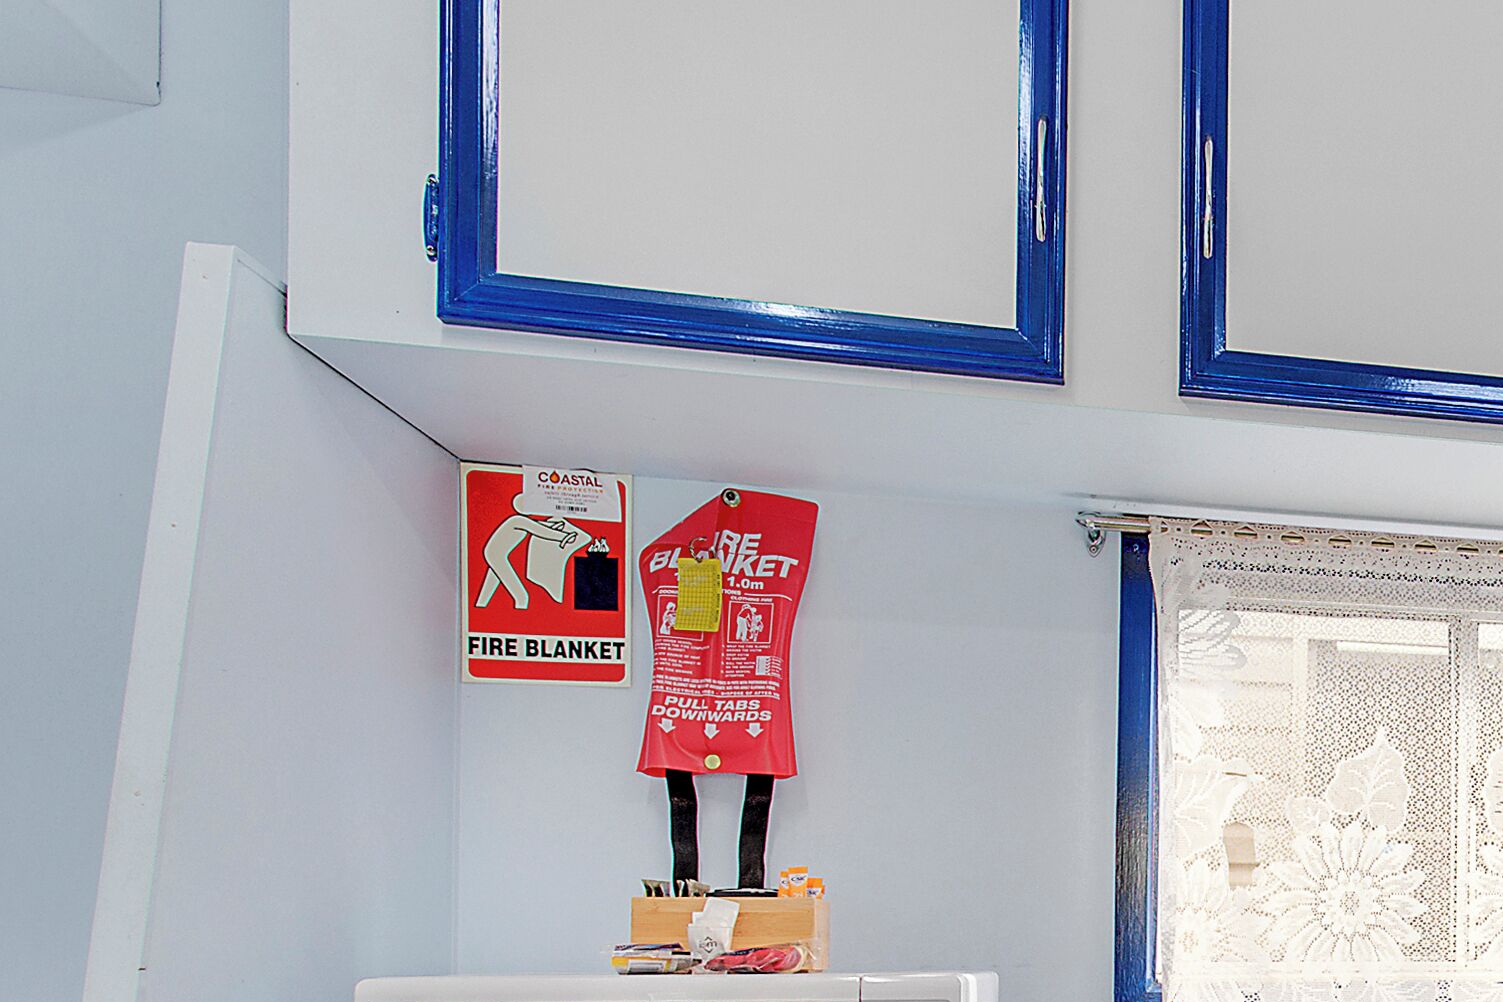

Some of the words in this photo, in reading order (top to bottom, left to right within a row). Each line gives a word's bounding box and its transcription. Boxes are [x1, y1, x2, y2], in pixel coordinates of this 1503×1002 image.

[538, 470, 603, 488] COASTAL
[468, 636, 518, 657] FIRE
[526, 639, 625, 660] BLANKET
[664, 695, 709, 710] PULL
[714, 699, 760, 711] TABS
[651, 705, 772, 722] DOWNWARDS
